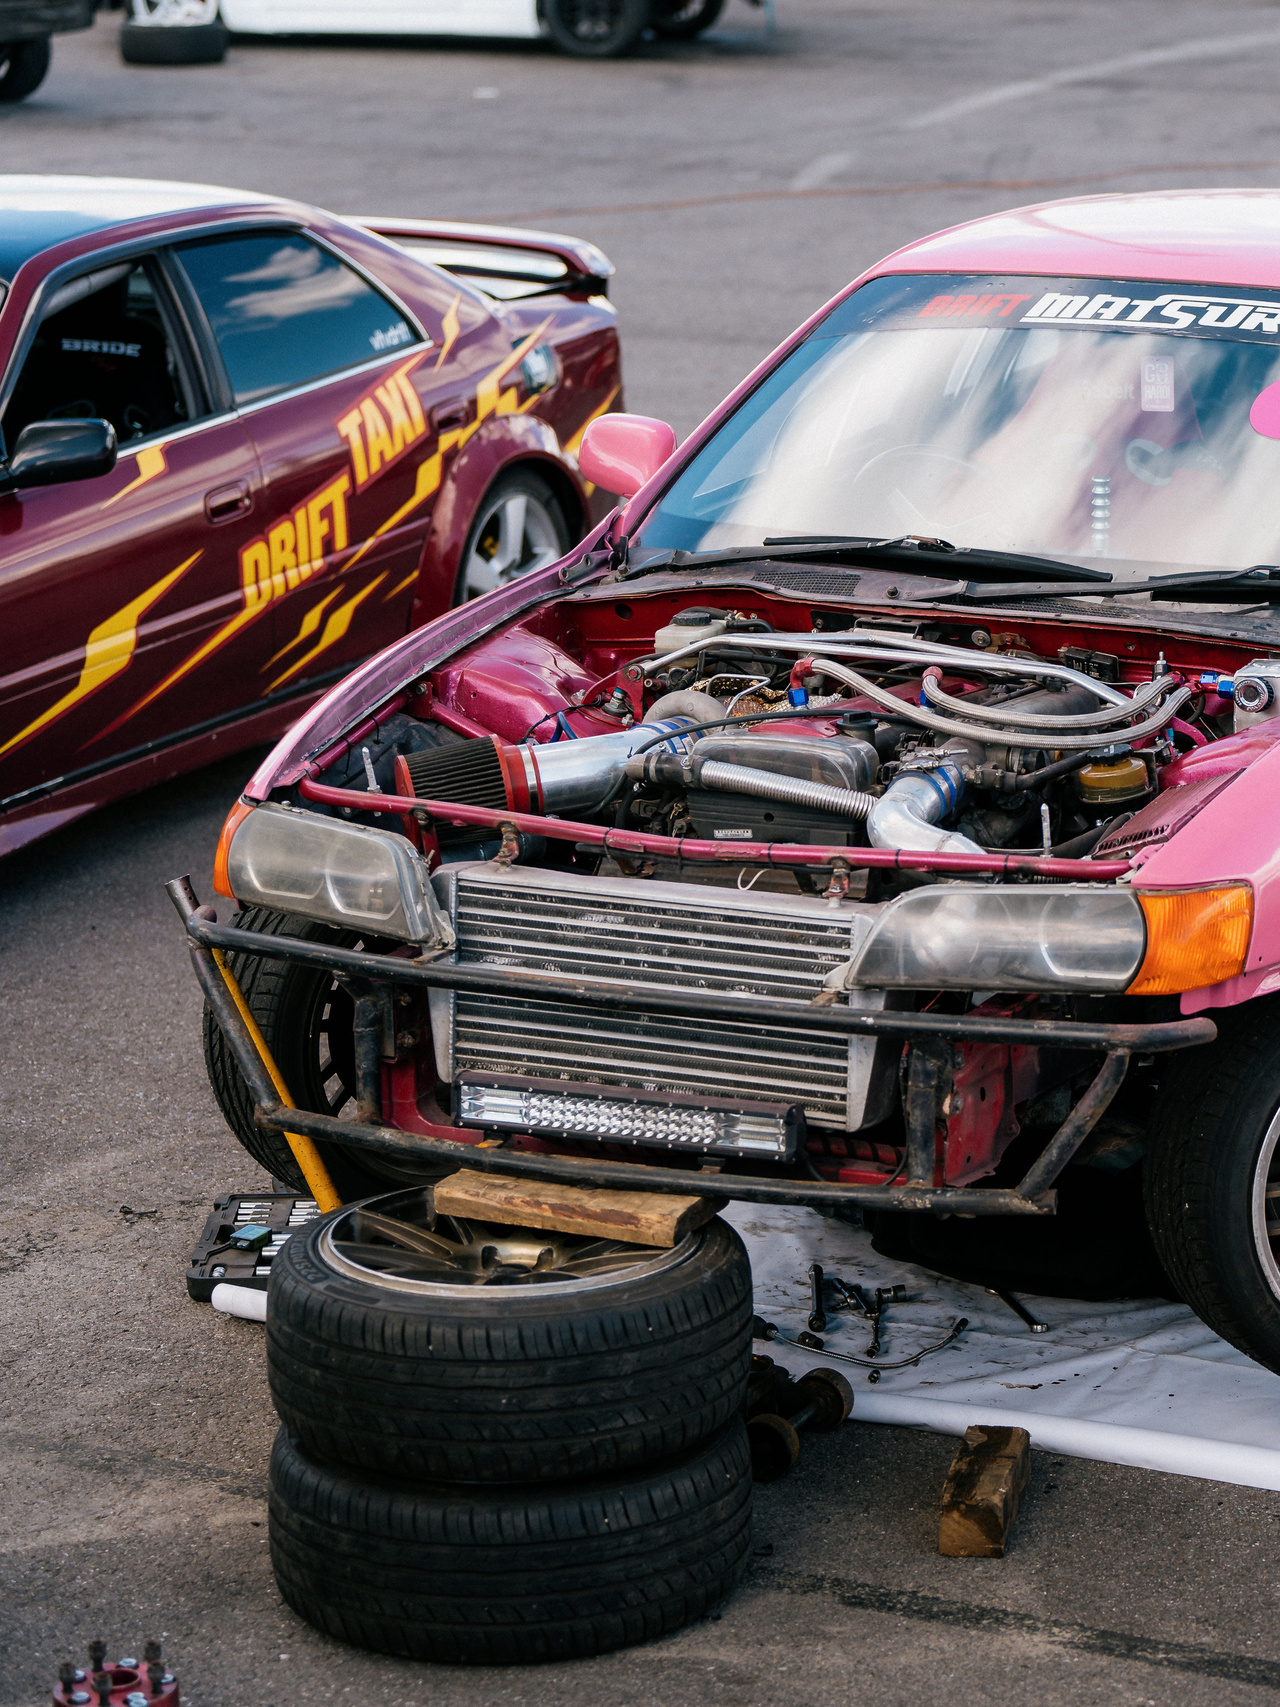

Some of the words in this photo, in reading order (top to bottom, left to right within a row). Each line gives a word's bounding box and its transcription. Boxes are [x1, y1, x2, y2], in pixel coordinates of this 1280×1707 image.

[917, 294, 1033, 318] DRIFT
[61, 338, 142, 358] BRIDE
[241, 473, 350, 608] DRIFT
[337, 370, 427, 487] TAXI
